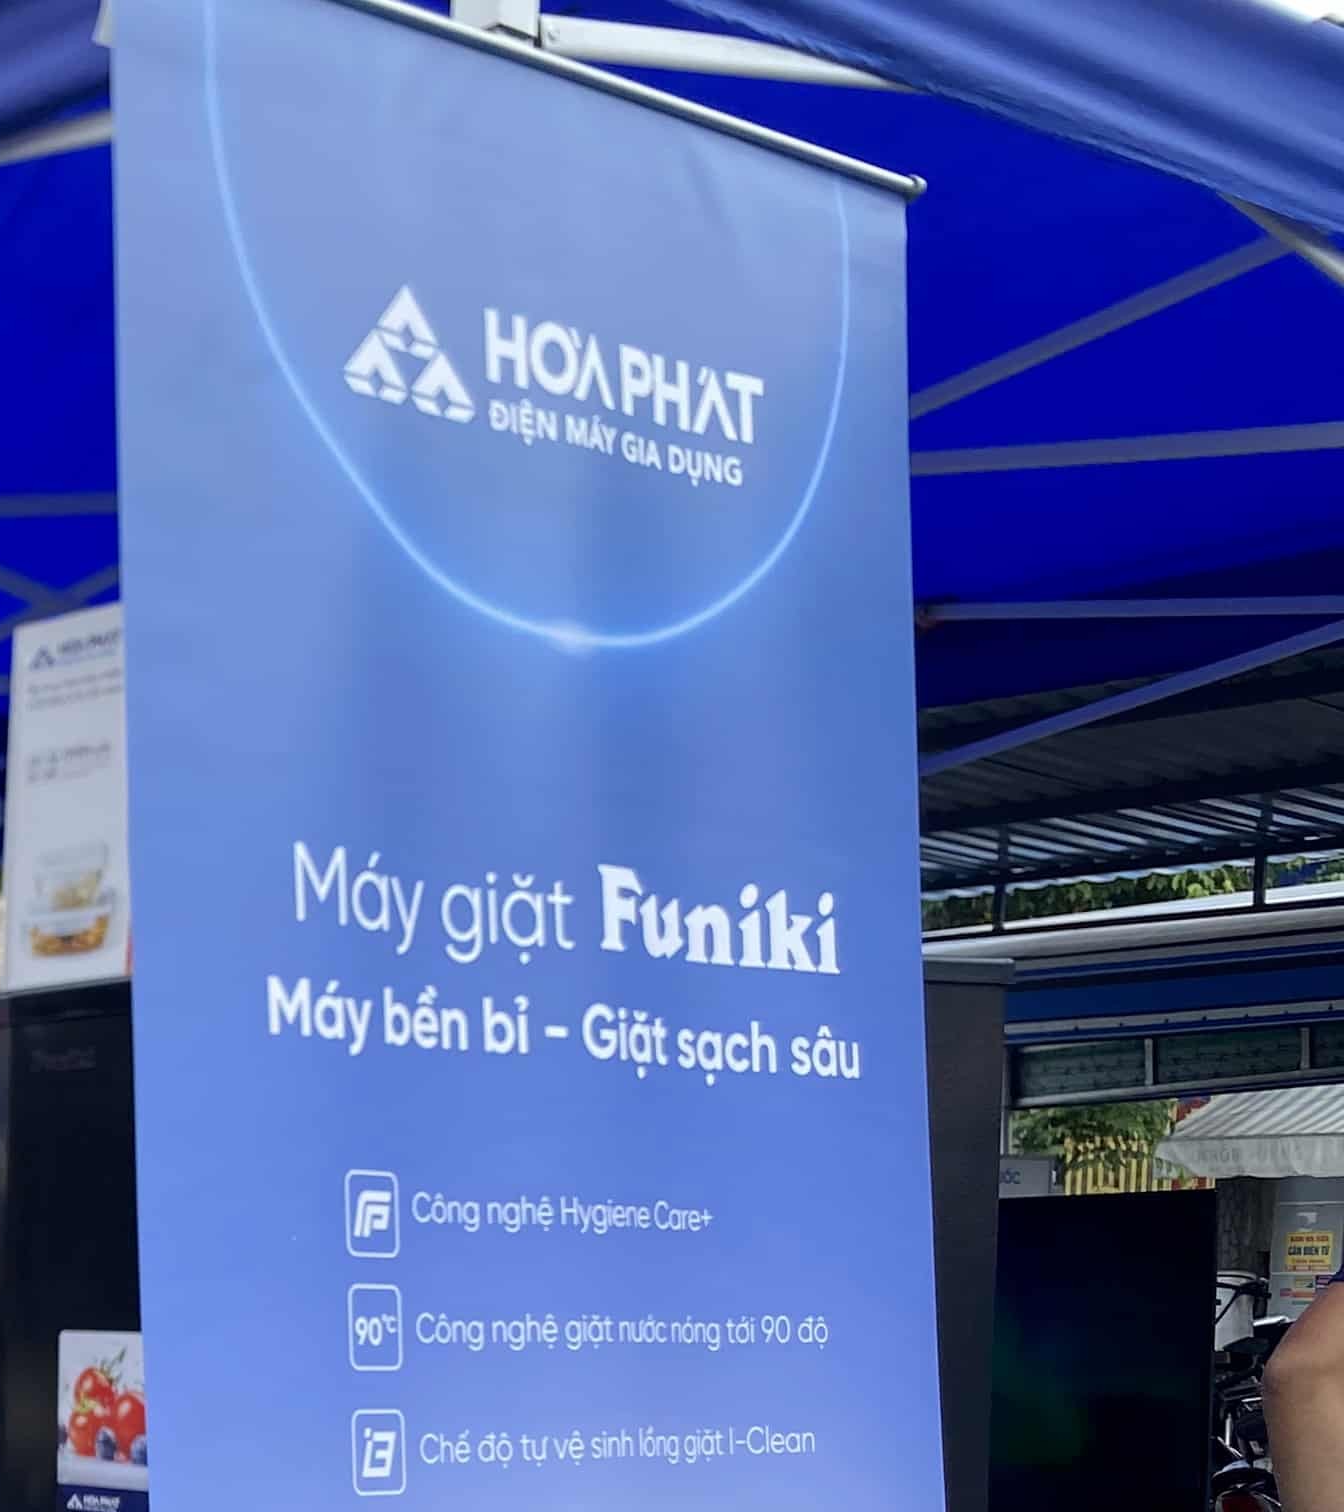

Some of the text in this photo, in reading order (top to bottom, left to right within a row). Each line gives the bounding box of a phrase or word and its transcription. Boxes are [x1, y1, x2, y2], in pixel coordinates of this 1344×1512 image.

[483, 307, 764, 445] HÒA PHÁT
[488, 398, 743, 487] ĐIỆN MÁY GIA DỤNG
[293, 840, 841, 974] Máy giặt Funiki
[266, 974, 372, 1056] Máy
[383, 986, 469, 1052] bền
[483, 995, 529, 1054] bỉ
[582, 1002, 669, 1079] Giặt
[677, 1020, 777, 1086] sạch
[791, 1024, 861, 1079] sâu
[413, 1190, 713, 1235] Công nghệ Hygiene Care+
[415, 1312, 829, 1351] Công nghệ giặt nước nóng tới 90 độ
[419, 1429, 472, 1464] Chế
[477, 1430, 513, 1468] độ
[520, 1431, 548, 1467] tự
[552, 1429, 585, 1466] vệ
[591, 1429, 634, 1459] sinh
[683, 1428, 723, 1464] giặt
[728, 1425, 816, 1457] I-Clean
